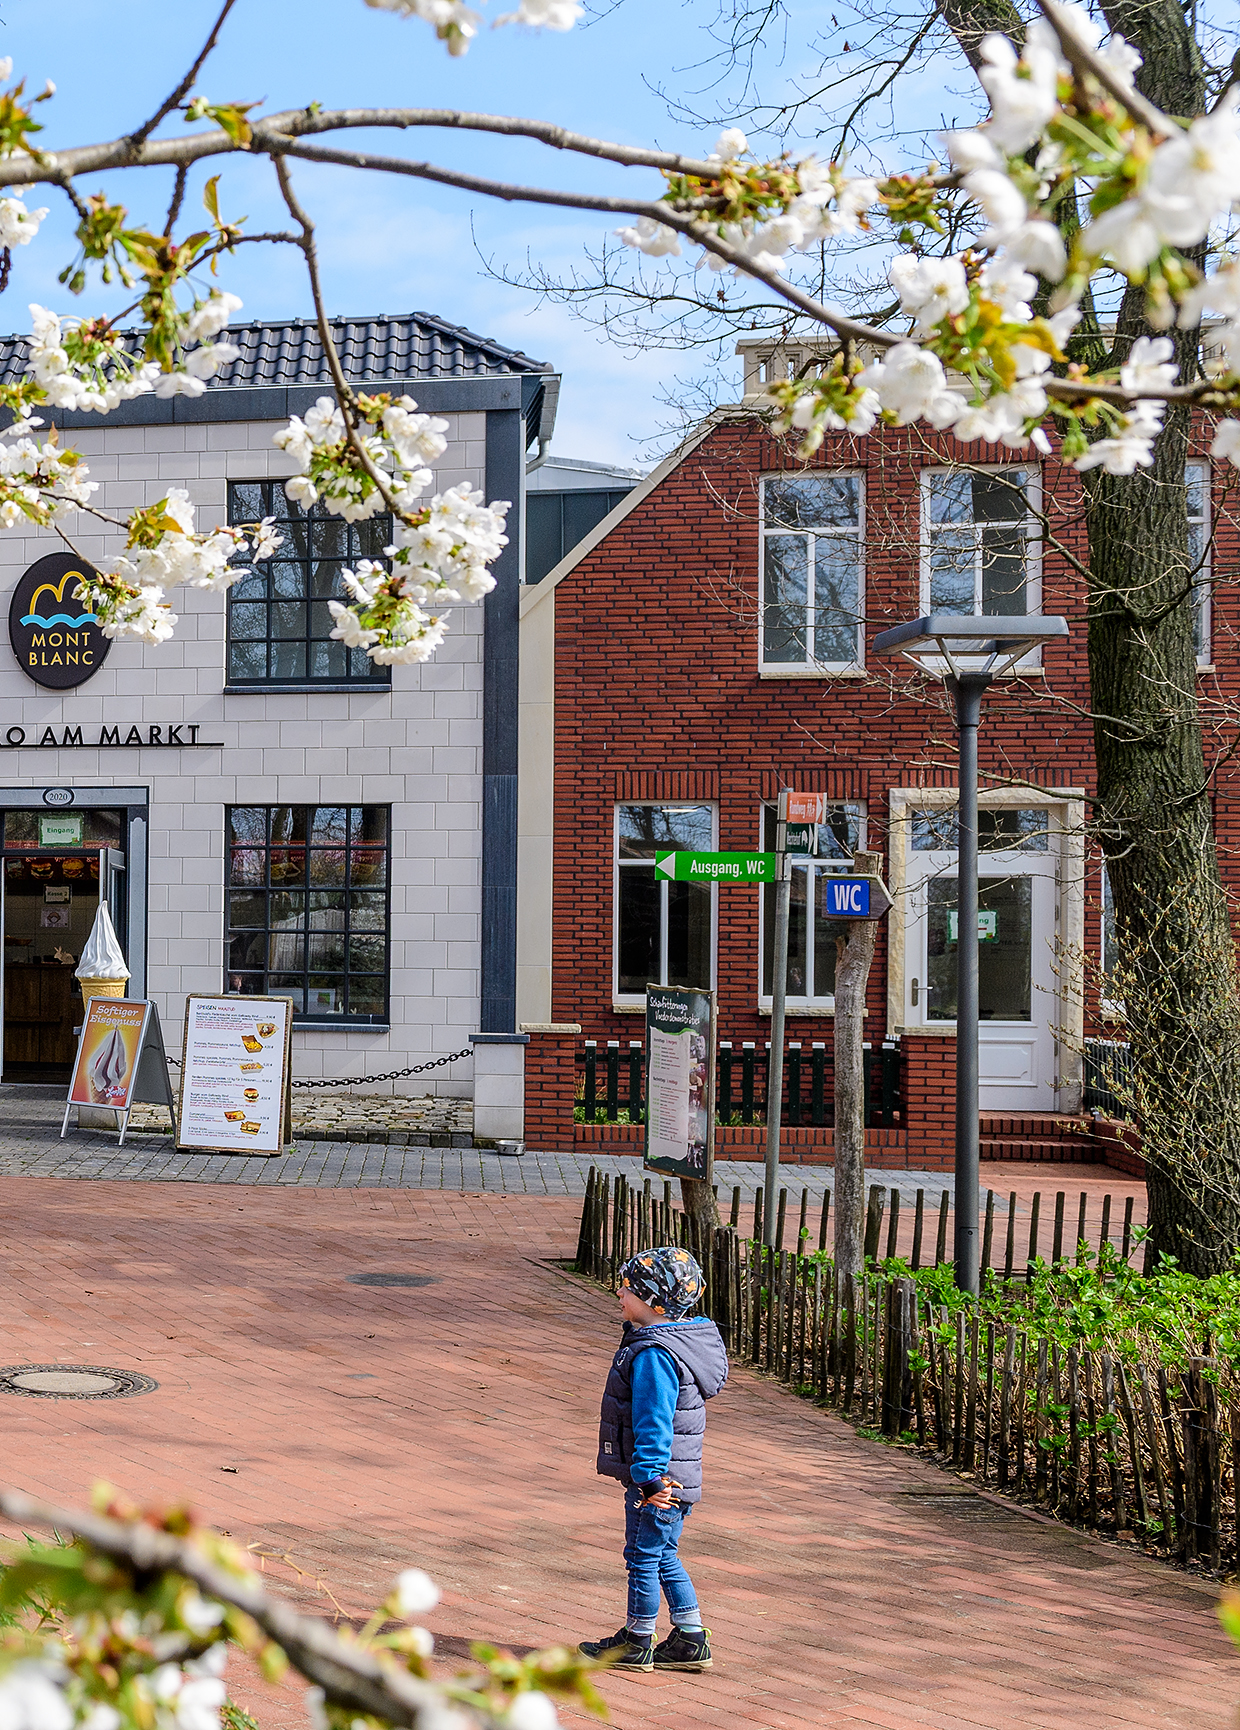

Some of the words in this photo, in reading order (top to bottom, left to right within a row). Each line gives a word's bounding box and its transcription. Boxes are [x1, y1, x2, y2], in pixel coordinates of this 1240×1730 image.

[31, 632, 90, 647] MONT
[29, 650, 93, 666] BLANC
[40, 725, 84, 745] AM
[99, 725, 200, 745] MARKT
[49, 793, 68, 801] 2020
[47, 827, 75, 835] Eingang
[690, 859, 743, 878] Ausgang,
[746, 860, 765, 875] WC
[834, 884, 862, 912] WC
[96, 1005, 139, 1018] Softiger
[89, 1014, 141, 1026] Eisgenuss
